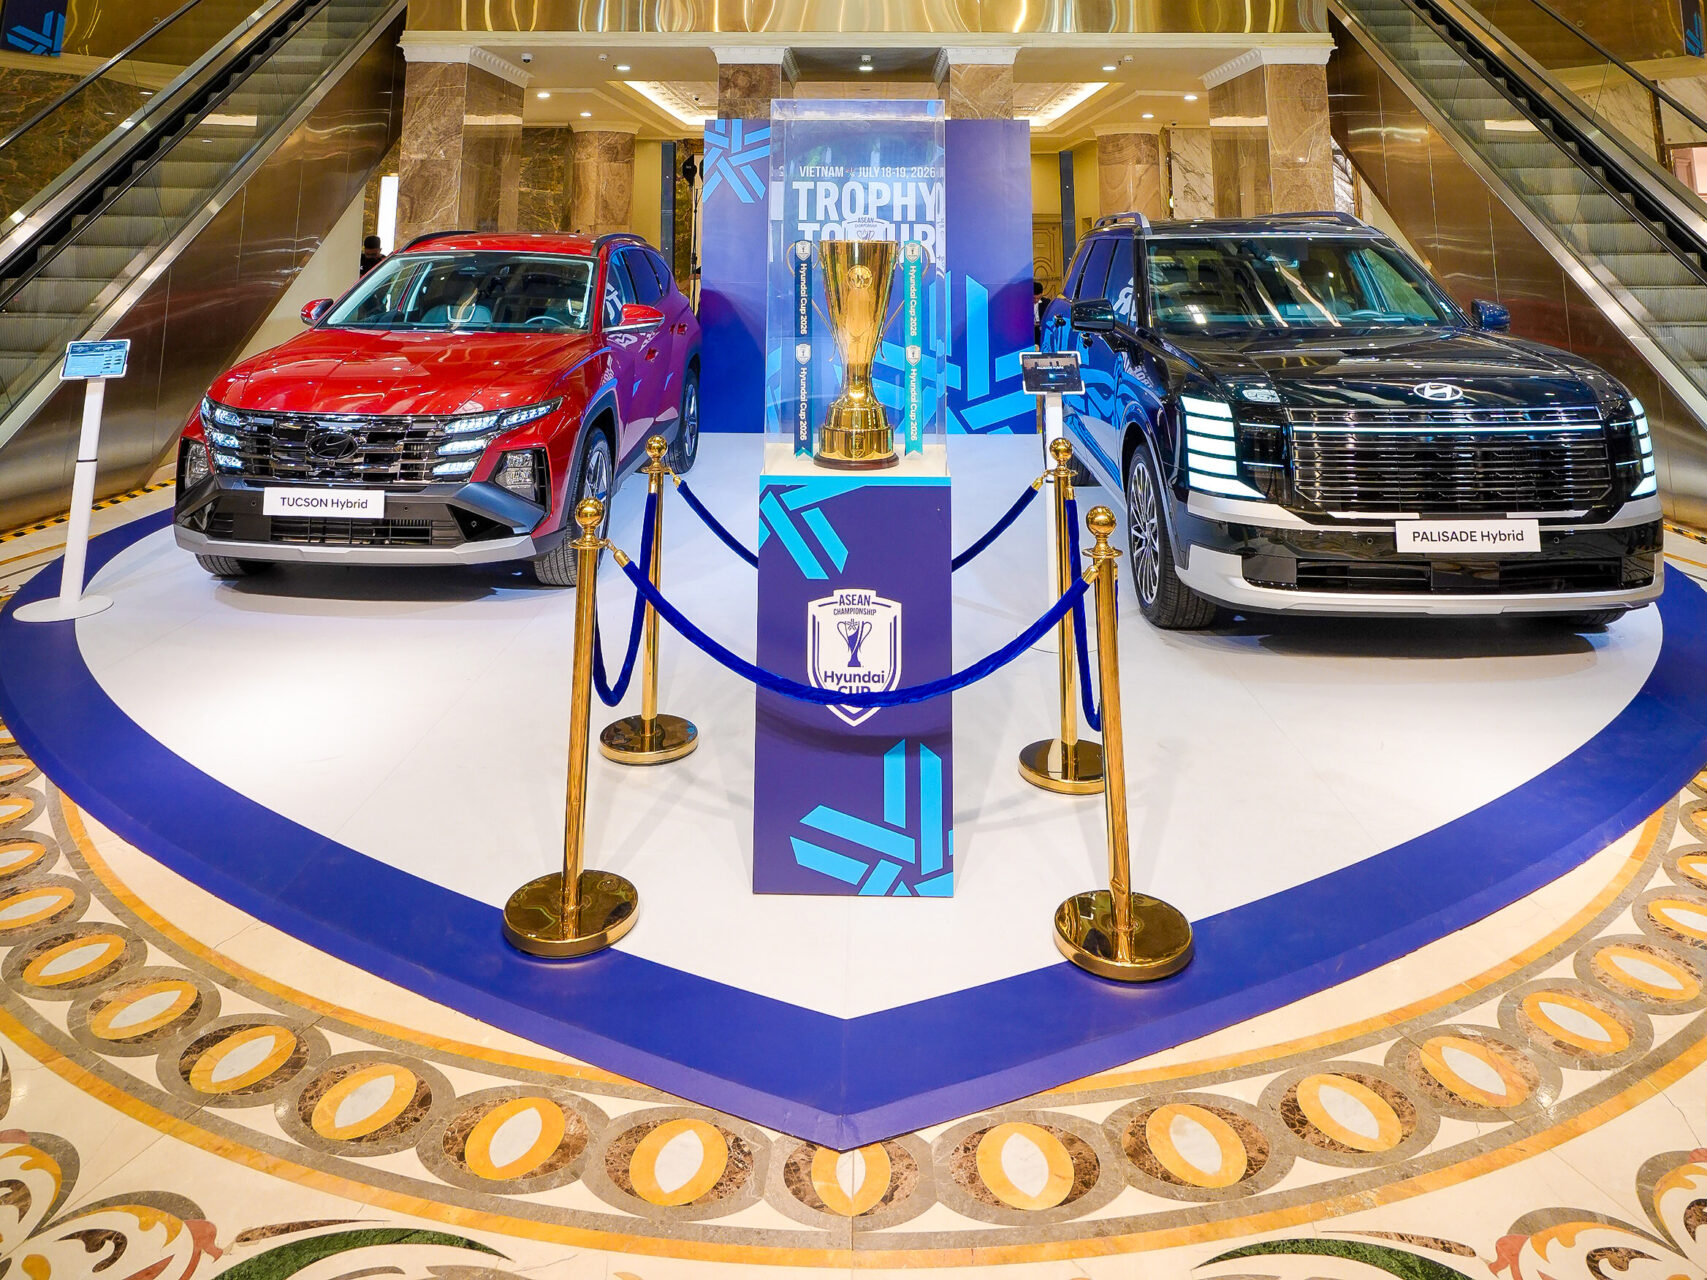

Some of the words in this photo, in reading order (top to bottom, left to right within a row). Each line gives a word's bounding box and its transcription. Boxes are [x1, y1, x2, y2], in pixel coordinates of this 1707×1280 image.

[799, 166, 844, 178] VIETNAM
[857, 166, 881, 178] JULY
[911, 166, 936, 178] 2026
[792, 181, 938, 221] TROPHY
[798, 263, 807, 297] Hyundai
[908, 265, 917, 299] Hyundai
[798, 297, 807, 317] Cup
[908, 299, 917, 317] Cup
[798, 317, 807, 335] 2026
[908, 318, 917, 337] 2026
[798, 367, 807, 402] Hyundai
[908, 368, 918, 403] Hyundai
[798, 402, 807, 423] Cup
[908, 403, 918, 422] Cup
[798, 423, 807, 441] 2026
[908, 422, 918, 441] 2026
[280, 496, 328, 508] TUCSON
[331, 498, 368, 510] Hybrid
[1412, 531, 1477, 542] PALISADE
[1481, 530, 1524, 544] Hybrid
[839, 594, 871, 606] ASEAN
[833, 607, 877, 616] CHAMPIONSHIP
[824, 670, 885, 686] Hyundai
